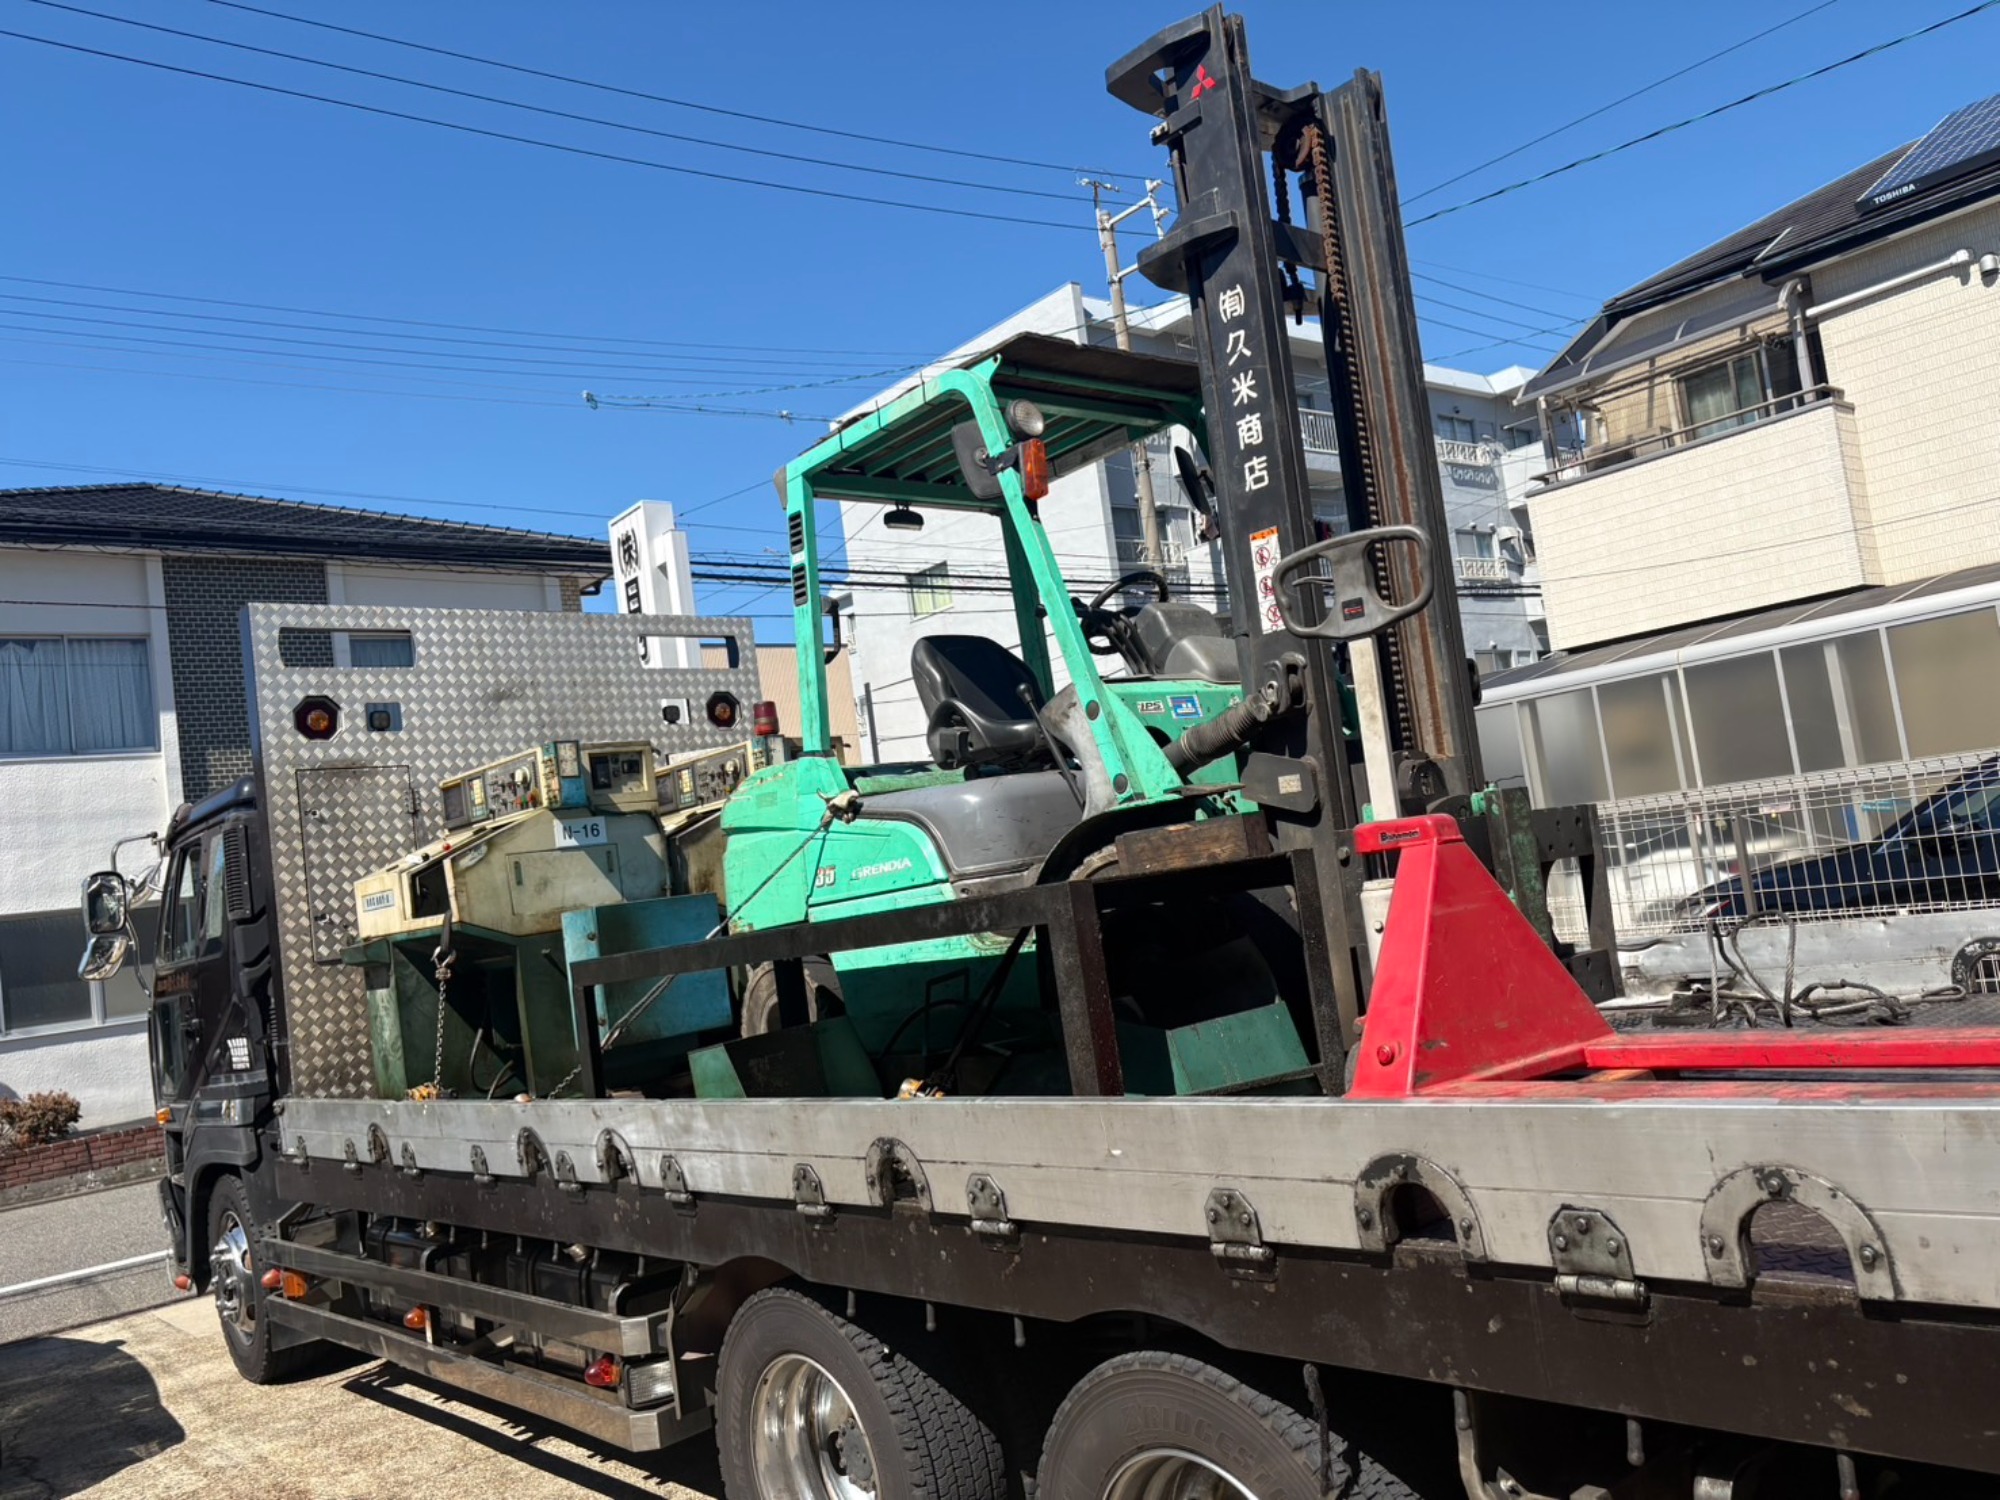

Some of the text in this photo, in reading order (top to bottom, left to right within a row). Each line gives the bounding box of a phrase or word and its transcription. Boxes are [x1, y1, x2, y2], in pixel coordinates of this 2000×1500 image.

[1873, 183, 1916, 204] TOSHIBA
[562, 823, 601, 840] N-16
[850, 857, 913, 879] GRENDIA
